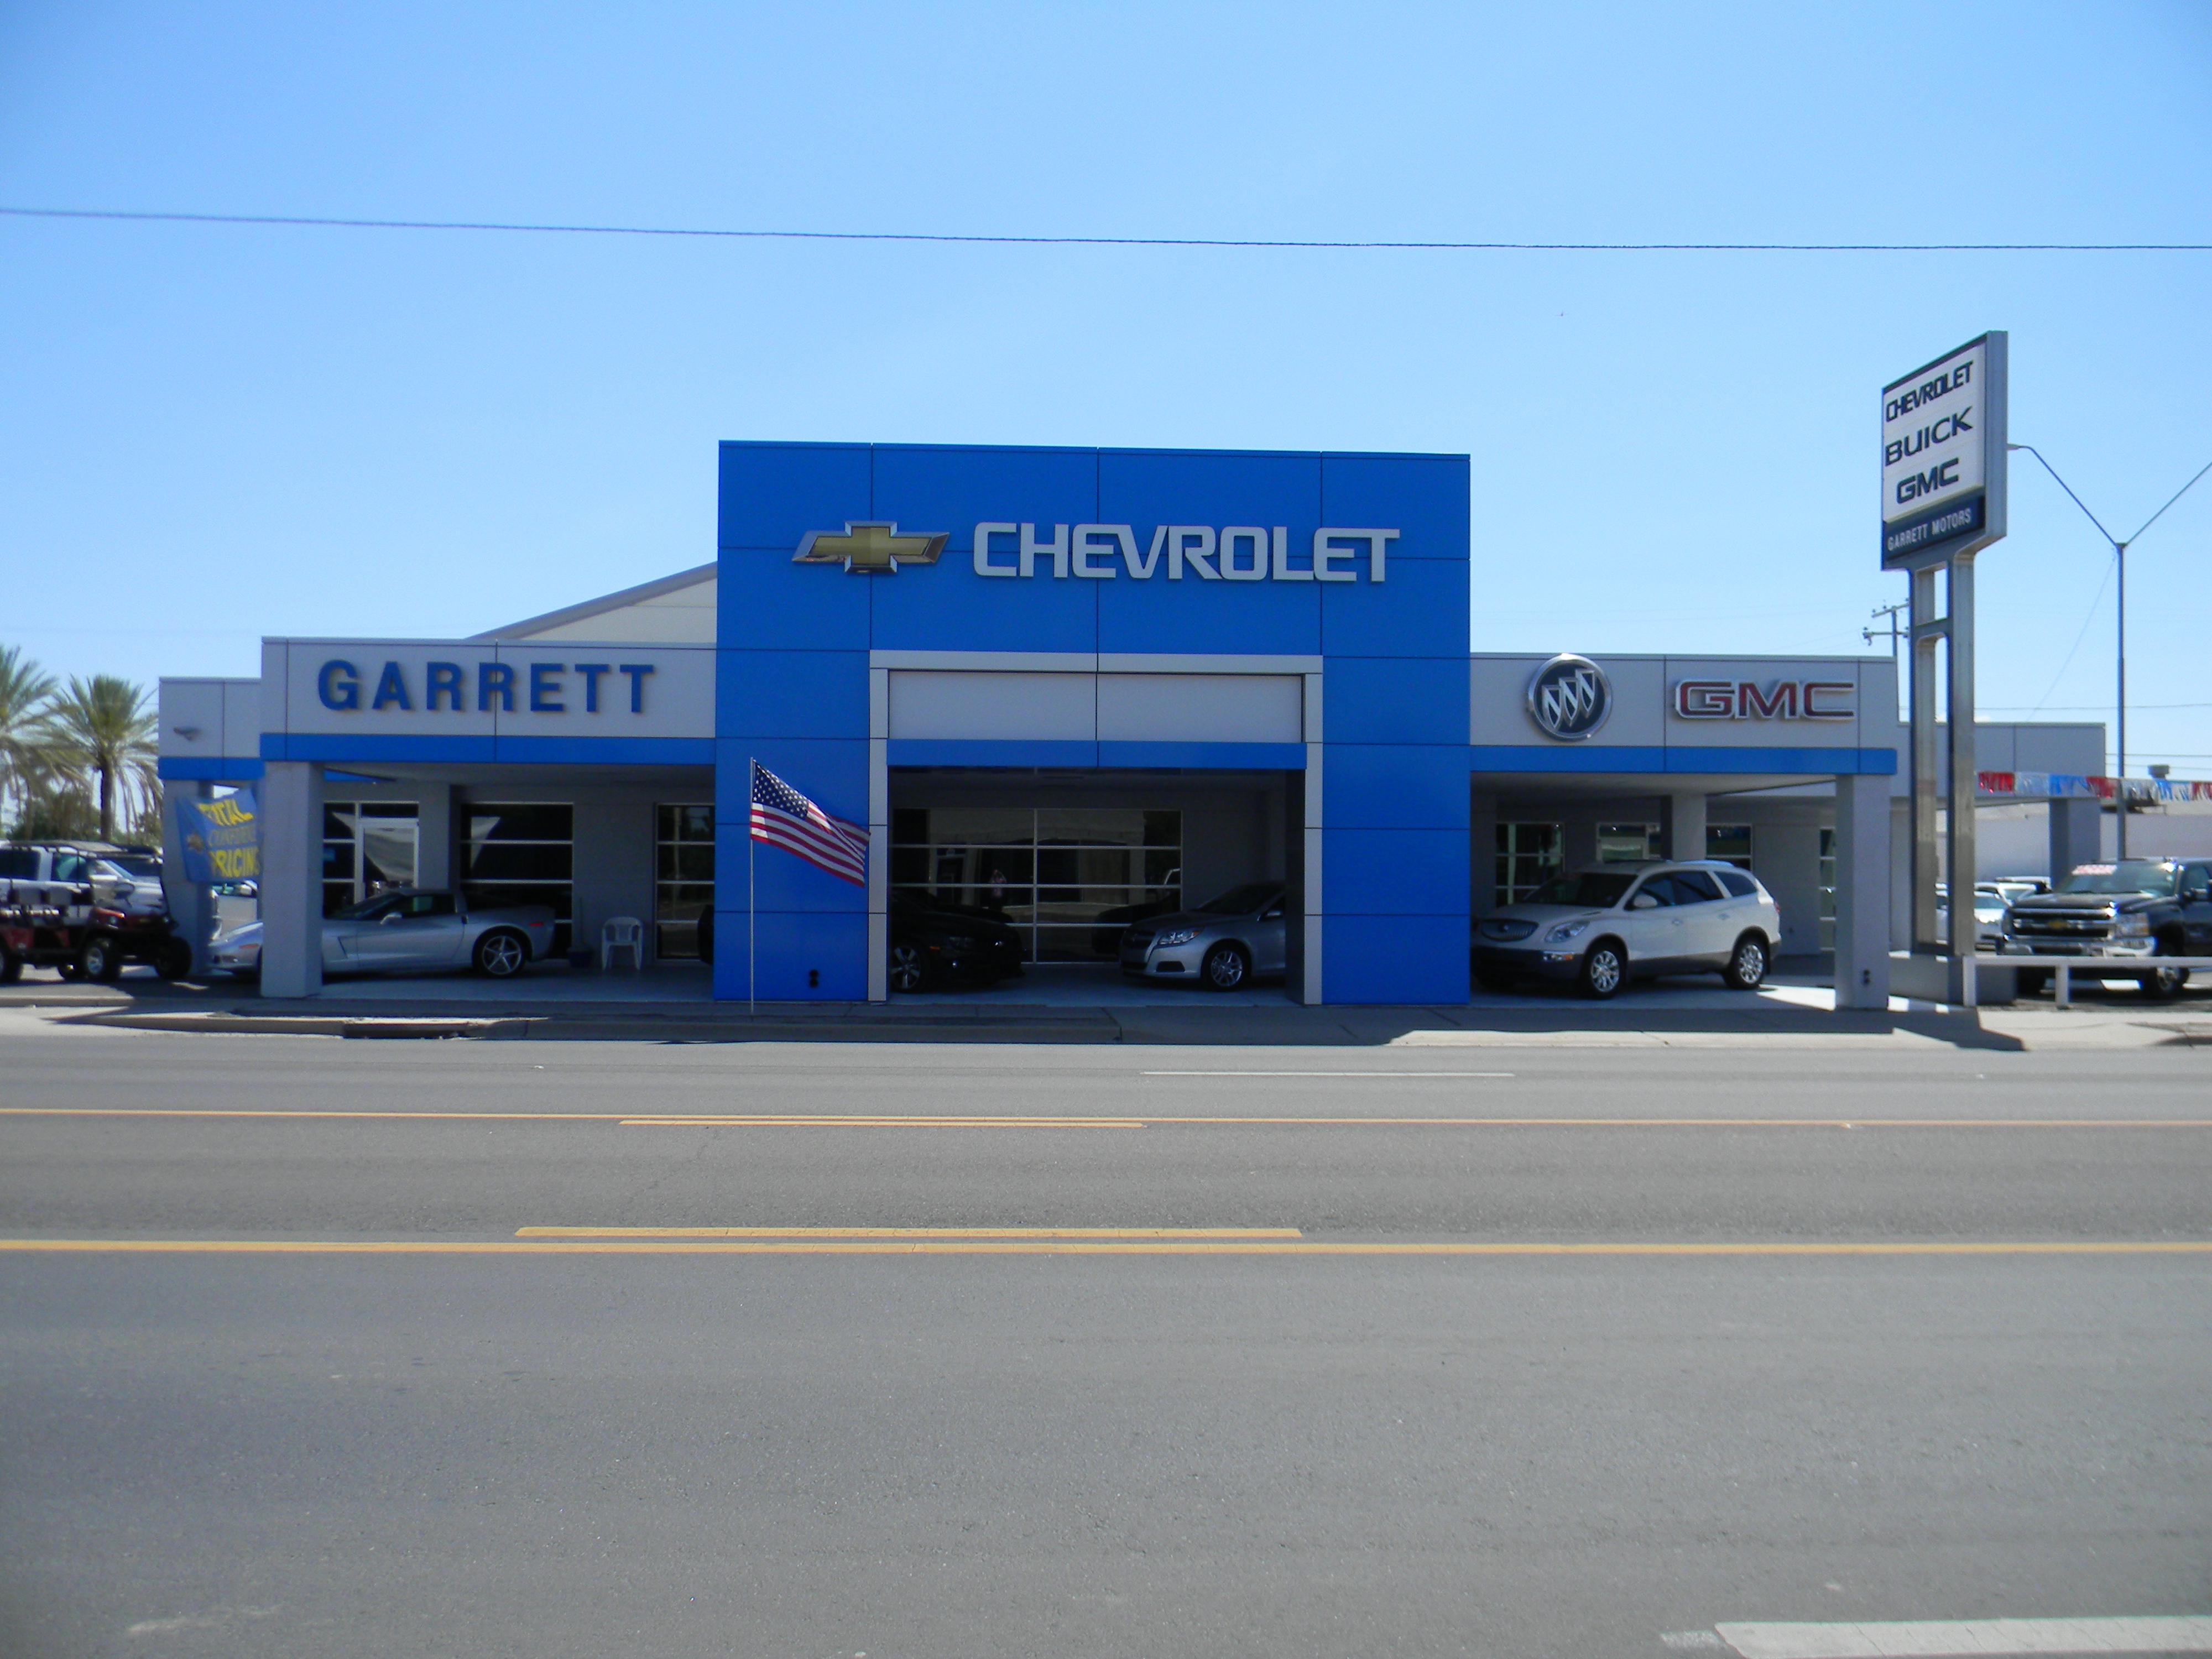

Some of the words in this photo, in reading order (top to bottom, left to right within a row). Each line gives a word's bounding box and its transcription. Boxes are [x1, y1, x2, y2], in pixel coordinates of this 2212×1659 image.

[1885, 359, 1974, 423] CHEVROLET
[1885, 405, 1974, 467] BUICK
[1896, 457, 1959, 505] GMC
[973, 521, 1400, 582] CHEVROLET
[1887, 523, 1928, 552] GARRETT
[1931, 507, 1972, 536] MOTORS
[317, 659, 655, 713] GARRETT
[1674, 679, 1855, 719] GMC
